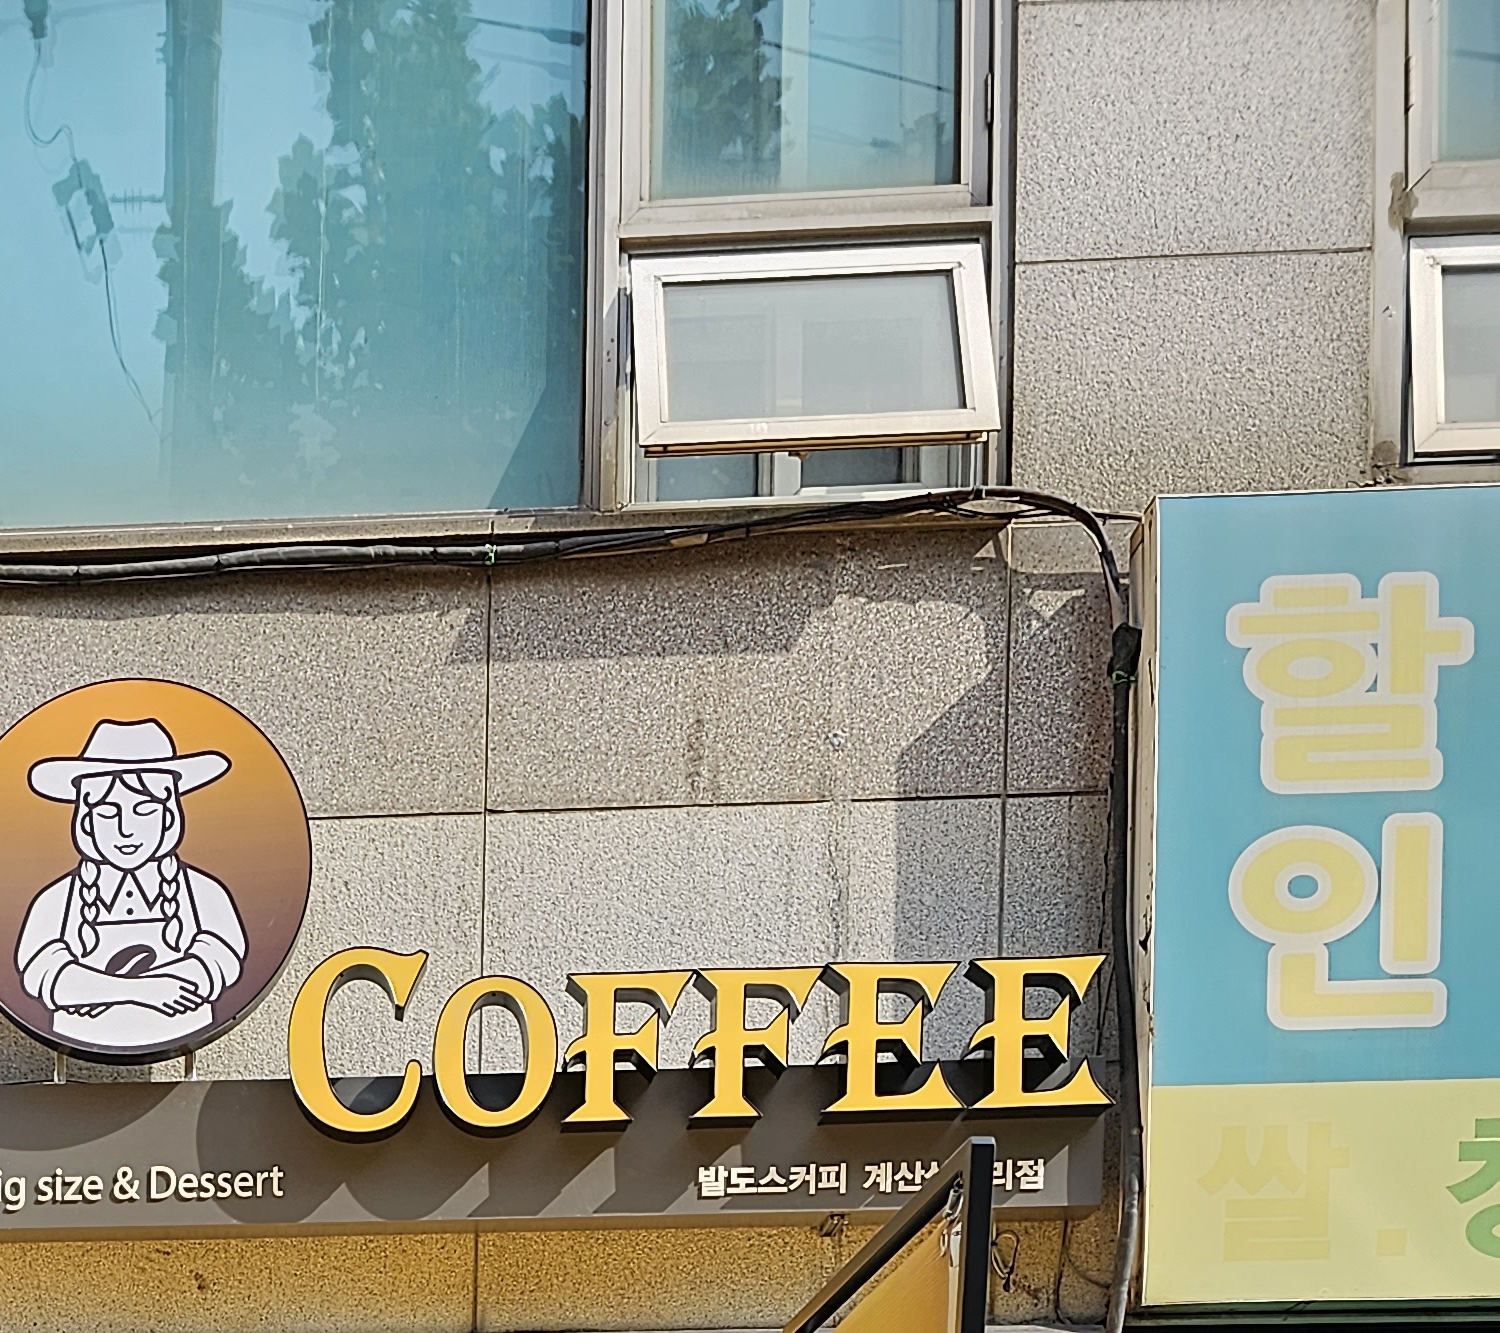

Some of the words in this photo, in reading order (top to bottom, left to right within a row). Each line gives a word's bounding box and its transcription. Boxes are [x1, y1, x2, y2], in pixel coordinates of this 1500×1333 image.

[288, 946, 1115, 1140] COFFEE
[37, 1167, 104, 1202] size
[113, 1166, 141, 1200] &
[150, 1165, 284, 1199] Dessert
[698, 1162, 848, 1197] 발도스커피
[862, 1158, 1046, 1193] 계산리점
